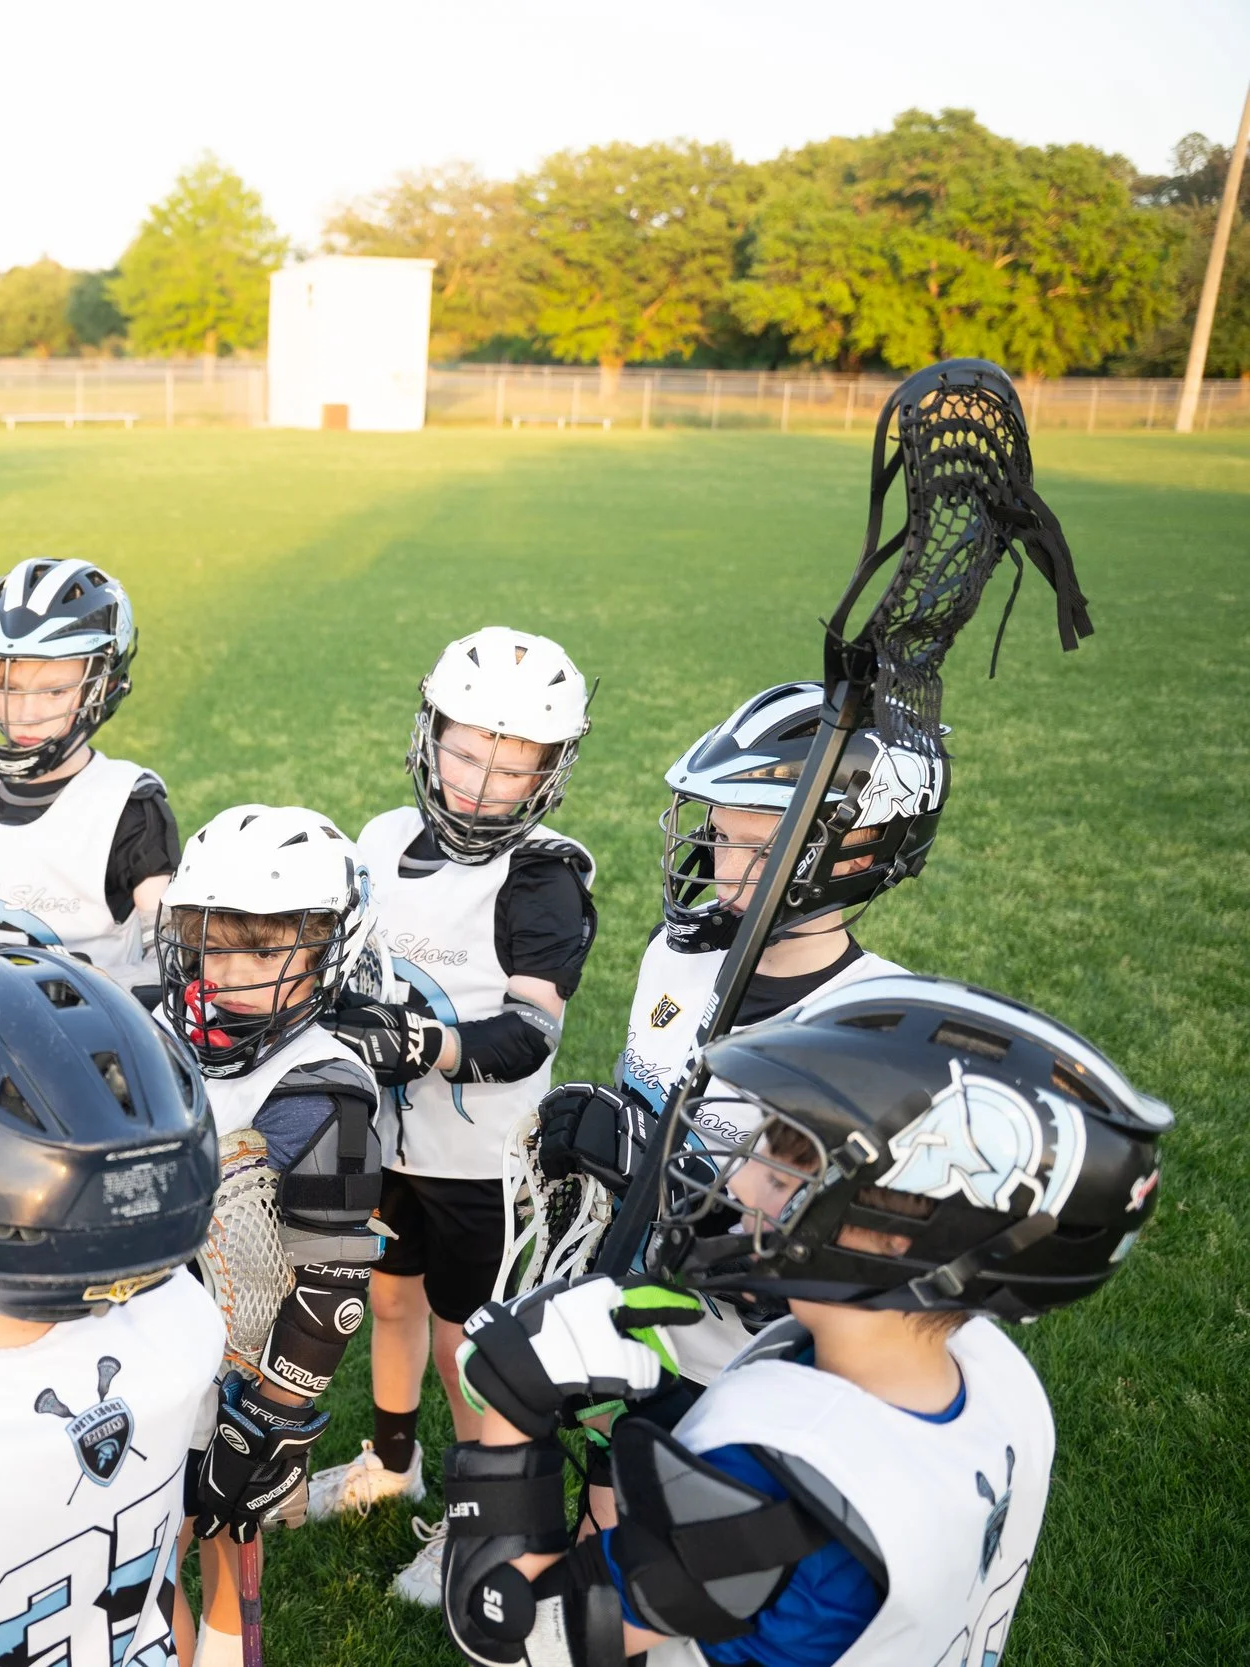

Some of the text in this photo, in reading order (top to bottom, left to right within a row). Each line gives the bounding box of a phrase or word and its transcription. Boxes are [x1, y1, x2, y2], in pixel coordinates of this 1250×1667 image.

[390, 932, 469, 967] Shore
[405, 1010, 426, 1067] STX
[246, 1466, 302, 1511] MAVERIK
[483, 1585, 504, 1623] 50
